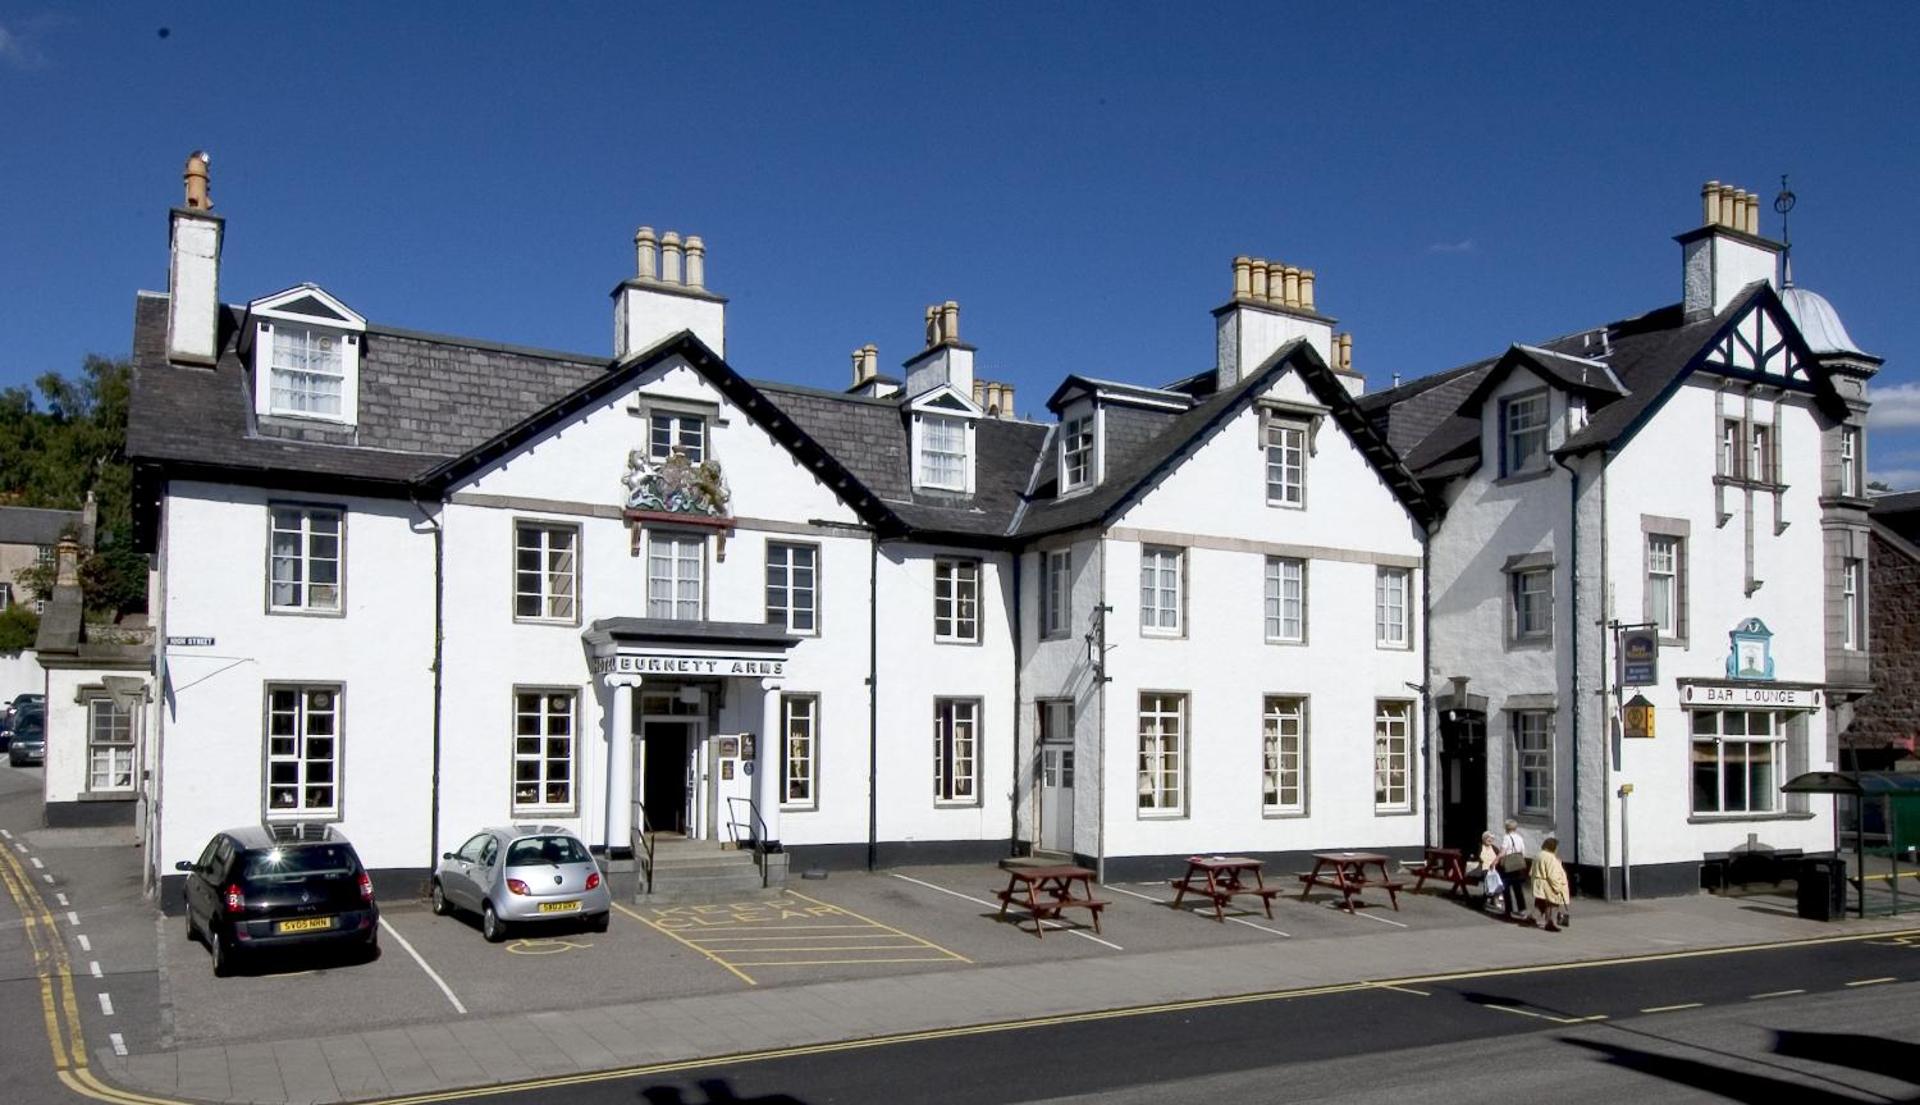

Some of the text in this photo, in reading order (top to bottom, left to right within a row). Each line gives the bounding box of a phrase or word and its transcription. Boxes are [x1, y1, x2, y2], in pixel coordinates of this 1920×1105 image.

[620, 657, 718, 673] BURNETT
[731, 662, 783, 675] ARMS
[1707, 689, 1795, 703] BAR LOUNGE
[651, 900, 796, 917] KEEP
[655, 907, 844, 928] CLEAR
